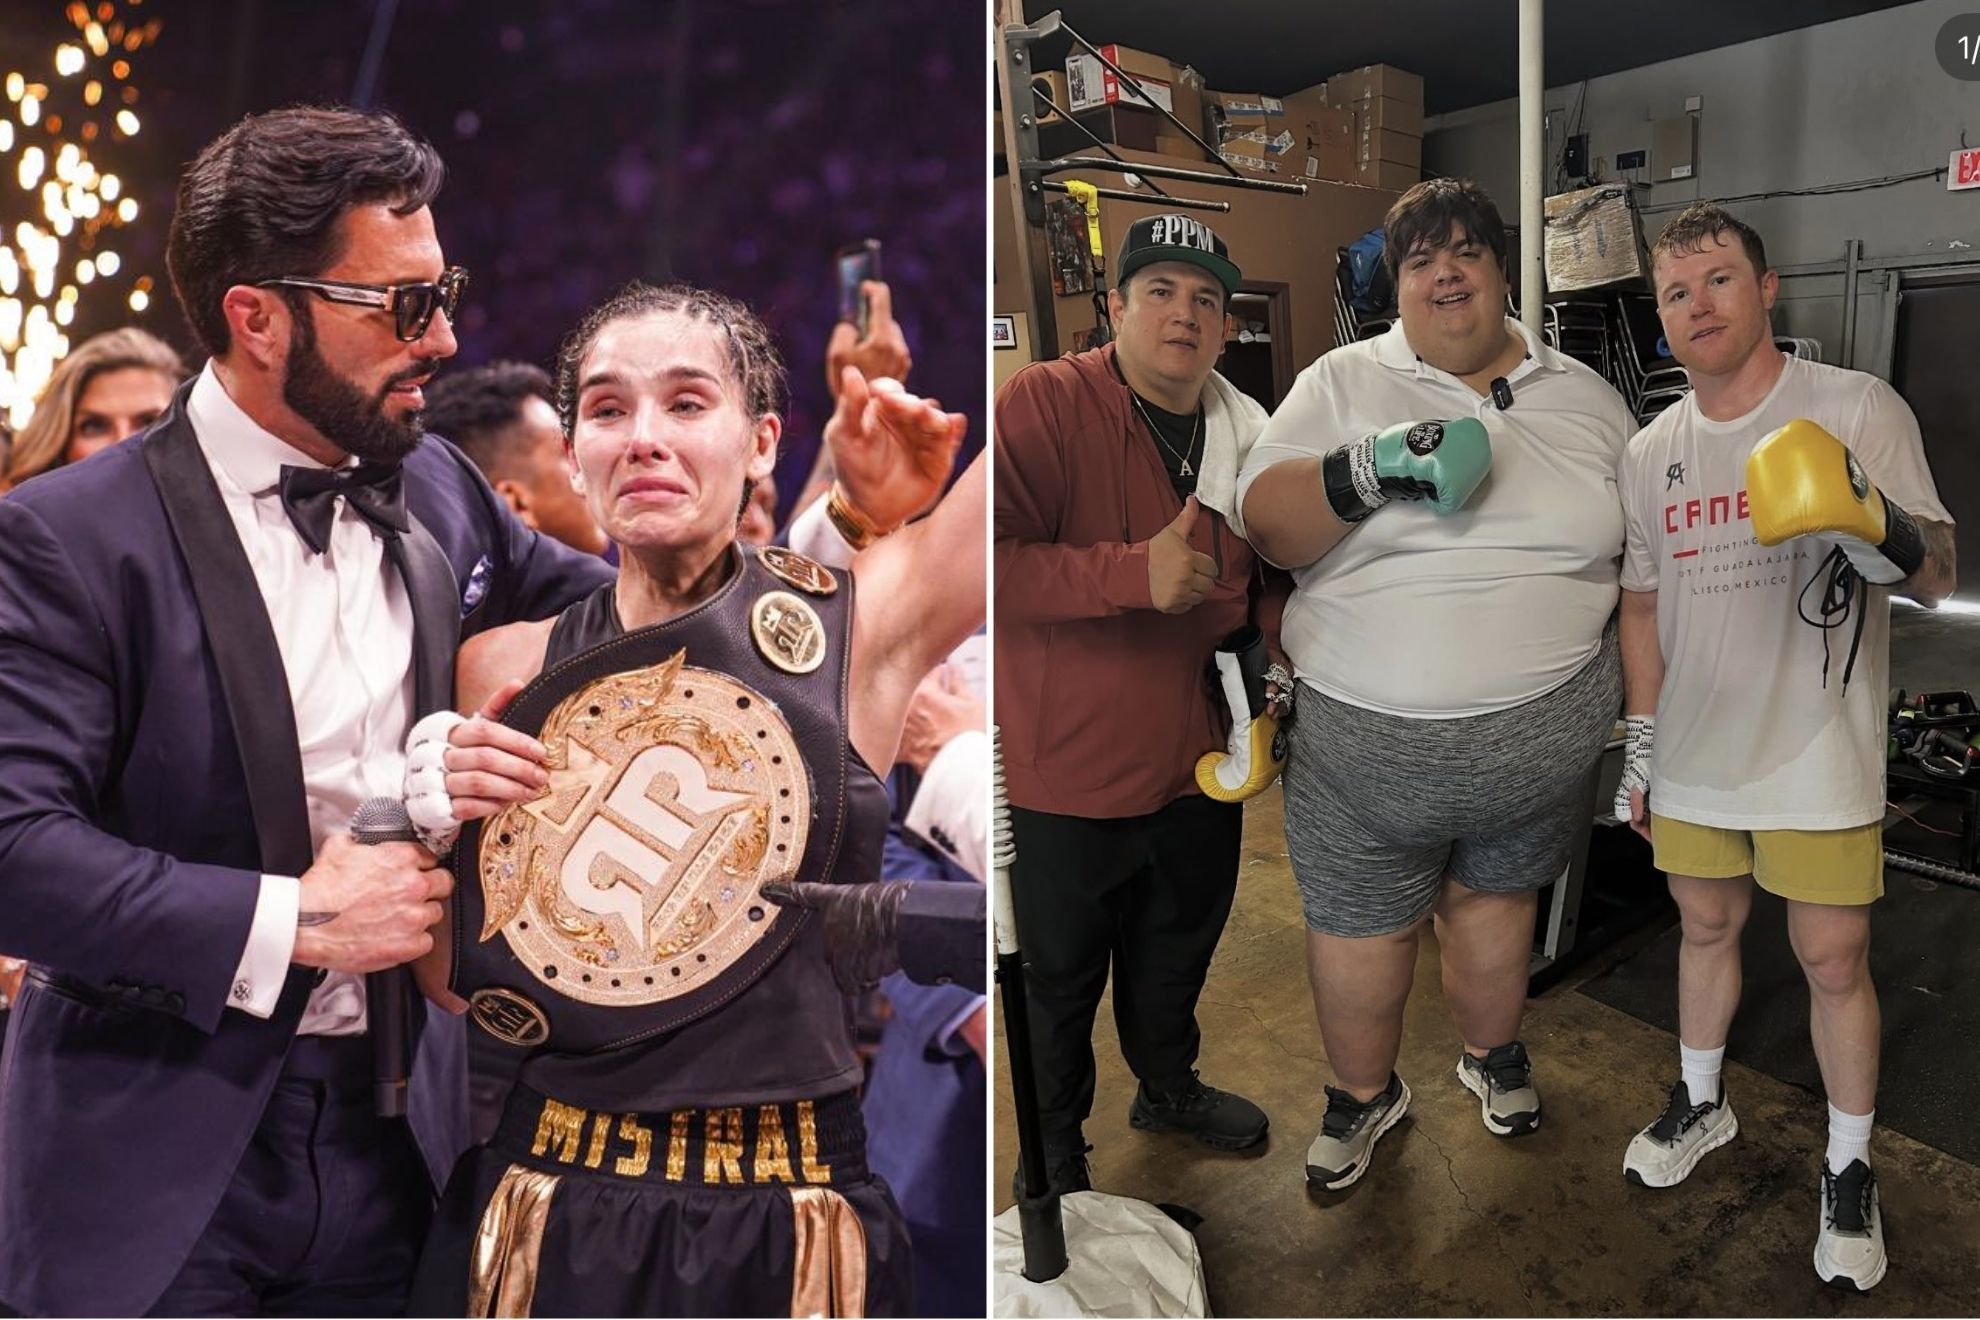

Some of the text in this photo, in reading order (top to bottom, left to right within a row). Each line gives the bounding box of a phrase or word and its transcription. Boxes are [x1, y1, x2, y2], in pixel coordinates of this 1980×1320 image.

[1957, 151, 1980, 184] EX
[1151, 215, 1214, 253] #PPM
[1665, 490, 1750, 534] CANE
[1702, 536, 1759, 553] FIGHTING
[531, 1099, 832, 1185] MISTRAL
